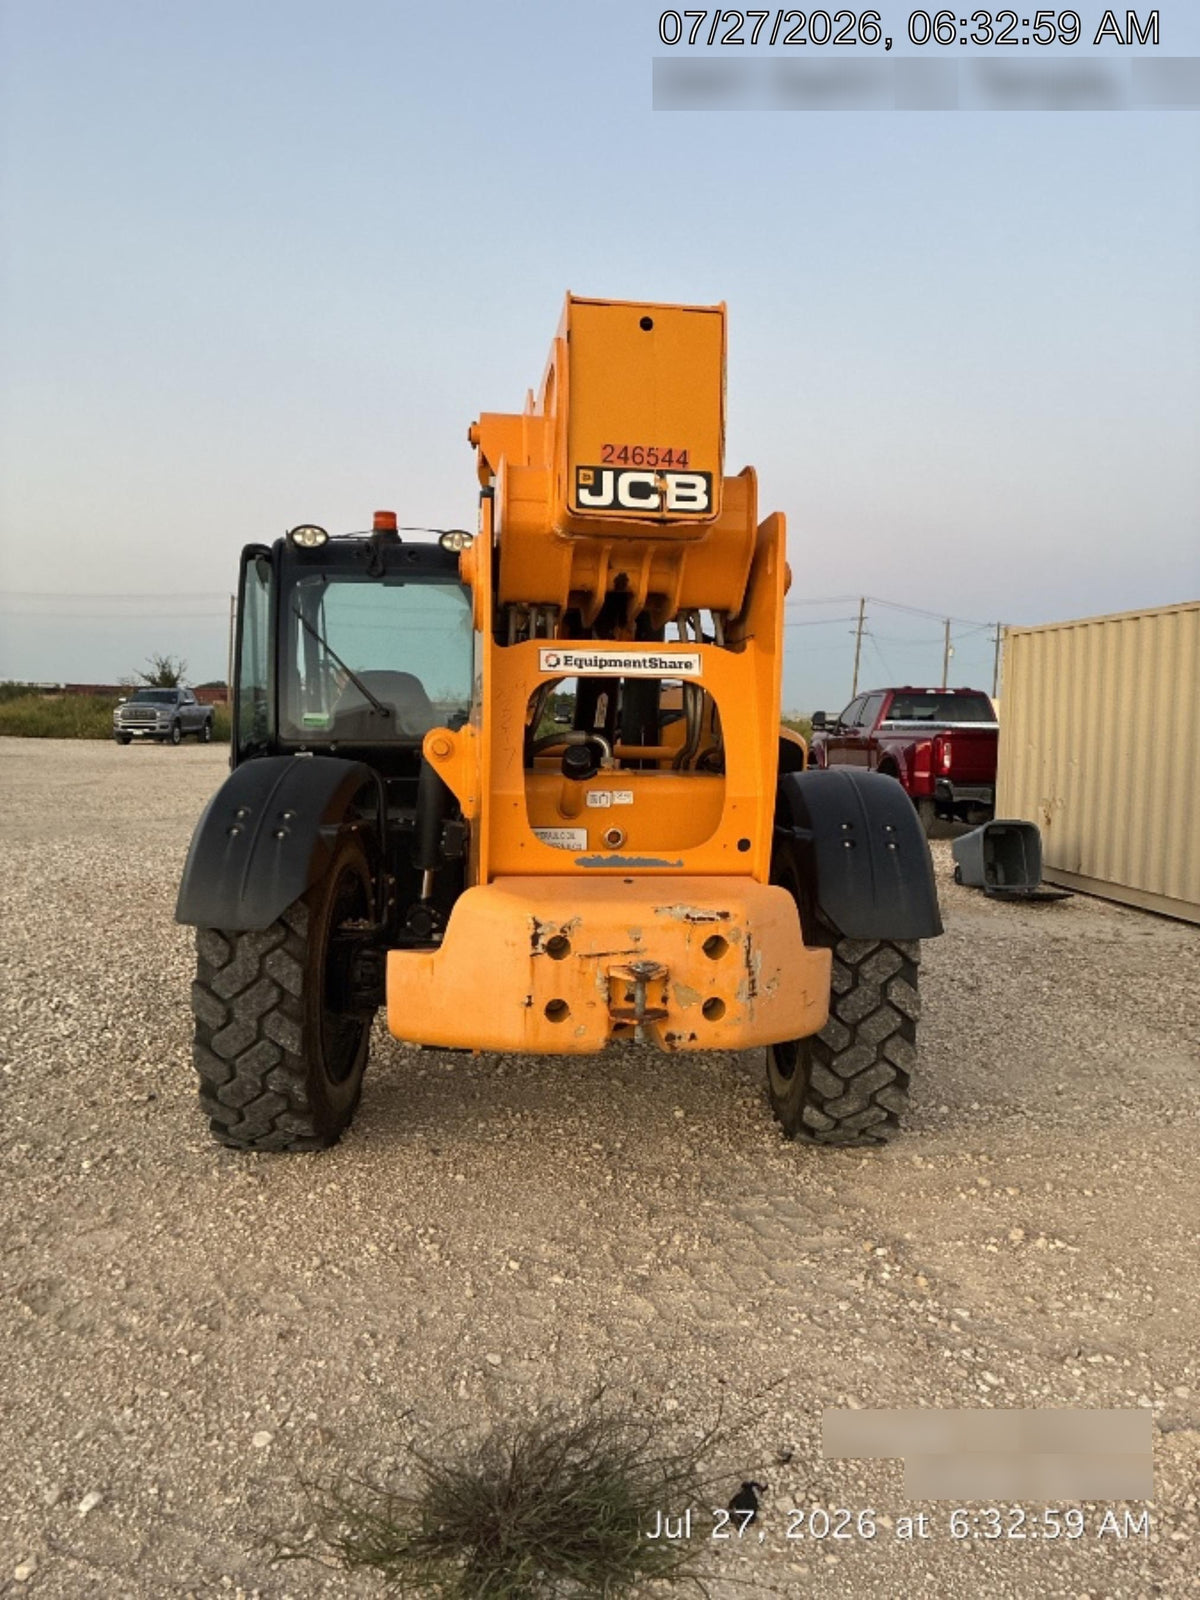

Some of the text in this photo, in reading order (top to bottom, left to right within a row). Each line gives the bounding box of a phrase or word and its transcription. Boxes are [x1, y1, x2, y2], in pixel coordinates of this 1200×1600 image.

[602, 444, 689, 468] 246544
[578, 470, 709, 511] JCB
[563, 655, 693, 670] EquipmentShare
